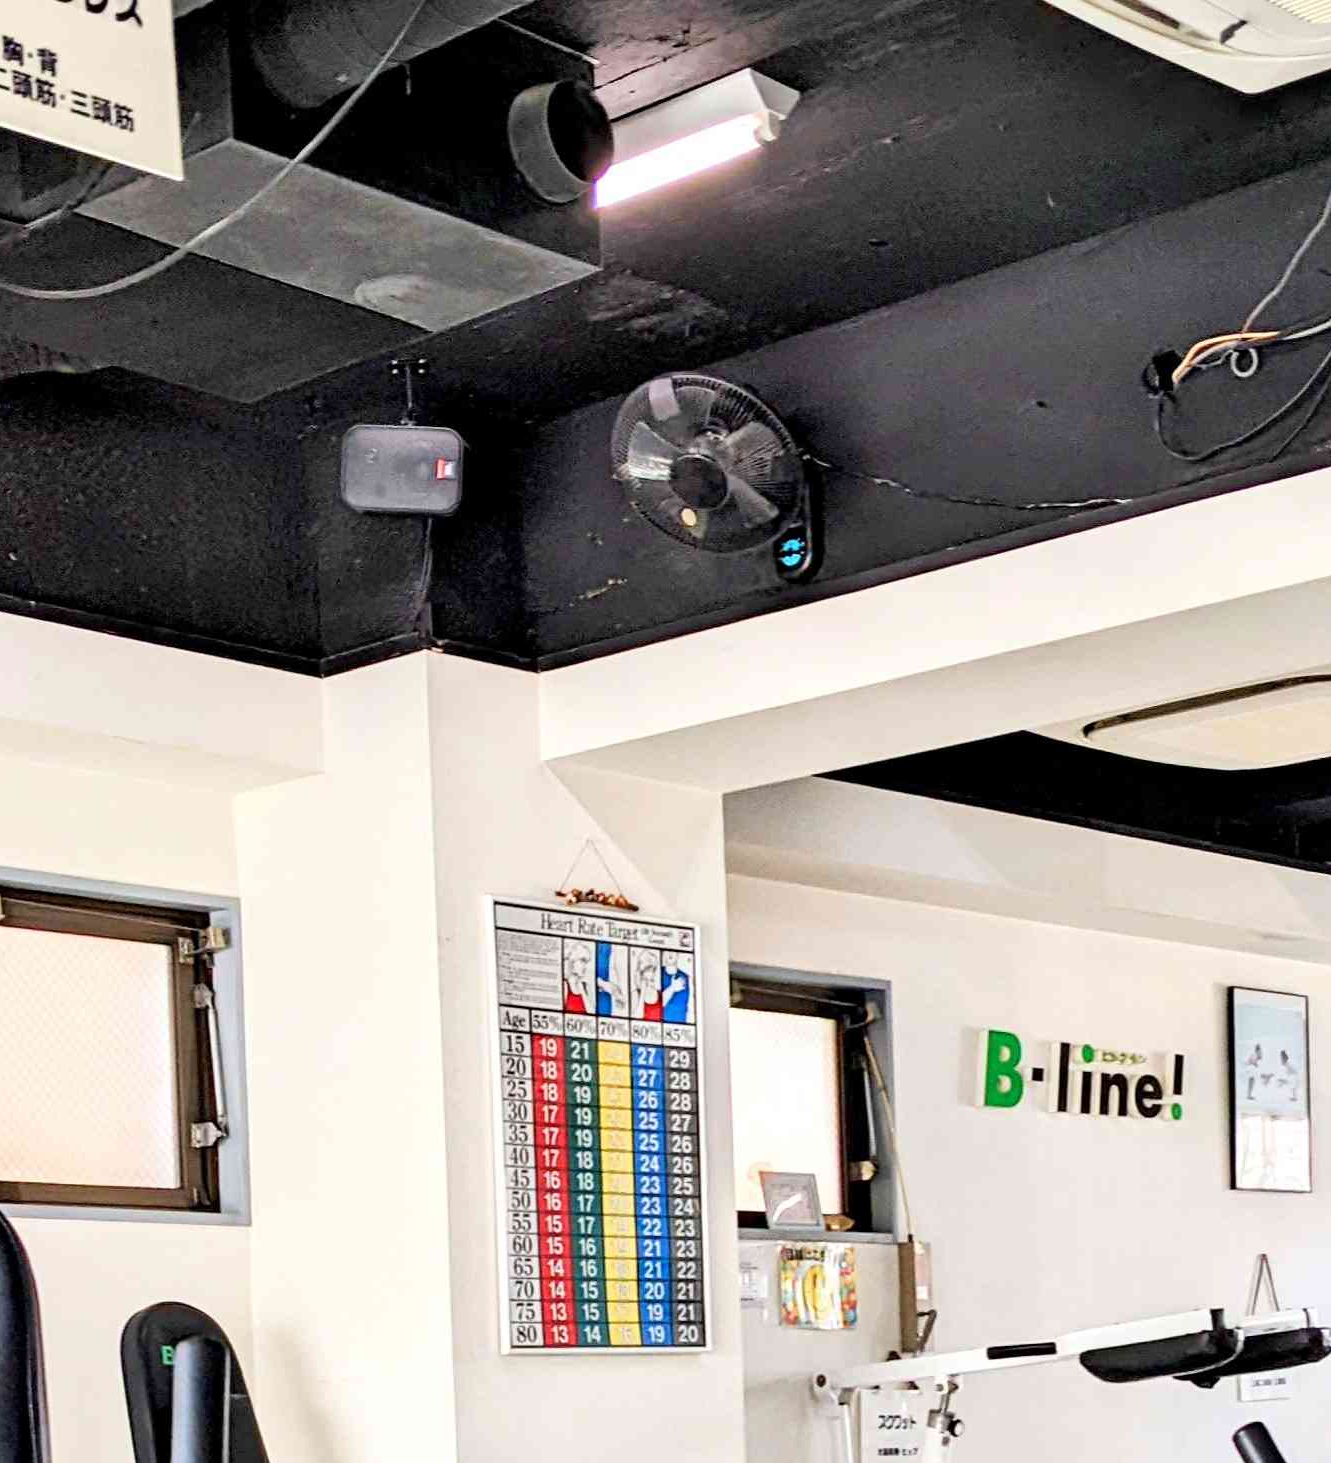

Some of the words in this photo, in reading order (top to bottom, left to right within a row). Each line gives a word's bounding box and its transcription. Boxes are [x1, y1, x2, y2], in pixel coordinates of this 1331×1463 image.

[541, 913, 573, 934] Heart
[578, 917, 604, 937] Rate
[605, 921, 637, 941] Target
[503, 1011, 526, 1028] Age
[532, 1014, 560, 1031] 55%
[565, 1017, 595, 1034] 60%
[600, 1021, 627, 1037] 70%
[633, 1024, 661, 1041] 80%
[507, 1035, 524, 1053] 15
[540, 1039, 557, 1057] 19
[571, 1041, 588, 1059] 21
[638, 1047, 656, 1065] 27
[669, 1050, 690, 1068] 29
[506, 1057, 526, 1075] 20
[541, 1061, 557, 1079] 18
[572, 1063, 591, 1081] 20
[638, 1069, 656, 1087] 27
[670, 1072, 690, 1090] 28
[507, 1080, 526, 1097] 25
[541, 1083, 558, 1101] 18
[574, 1086, 591, 1104] 19
[639, 1091, 658, 1109] 26
[671, 1093, 691, 1111] 28
[508, 1103, 527, 1120] 30
[542, 1105, 558, 1122] 17
[575, 1108, 592, 1125] 19
[639, 1112, 658, 1130] 25
[671, 1114, 691, 1132] 27
[509, 1124, 528, 1142] 35
[543, 1127, 559, 1145] 17
[576, 1129, 592, 1147] 19
[640, 1133, 659, 1151] 25
[672, 1135, 692, 1153] 26
[510, 1147, 529, 1165] 40
[543, 1149, 559, 1166] 17
[576, 1151, 593, 1169] 18
[640, 1155, 659, 1172] 24
[672, 1157, 693, 1174] 26
[510, 1169, 529, 1187] 45
[544, 1171, 560, 1189] 16
[577, 1173, 594, 1190] 18
[641, 1176, 660, 1194] 23
[673, 1177, 693, 1195] 25
[512, 1191, 530, 1210] 50
[545, 1193, 561, 1210] 16
[578, 1195, 594, 1212] 17
[641, 1197, 661, 1215] 23
[674, 1198, 694, 1215] 24
[513, 1213, 531, 1232] 55
[546, 1215, 562, 1232] 15
[578, 1216, 595, 1234] 17
[643, 1218, 661, 1236] 22
[675, 1219, 695, 1236] 23
[513, 1236, 532, 1253] 60
[547, 1237, 563, 1254] 15
[579, 1238, 596, 1256] 16
[644, 1239, 661, 1257] 21
[676, 1240, 696, 1257] 23
[514, 1258, 533, 1275] 65
[548, 1259, 564, 1276] 14
[581, 1259, 597, 1277] 16
[645, 1261, 661, 1278] 21
[677, 1262, 696, 1278] 22
[515, 1281, 534, 1298] 70
[549, 1281, 565, 1298] 14
[581, 1281, 598, 1299] 15
[645, 1282, 664, 1299] 20
[677, 1282, 694, 1299] 21
[516, 1303, 535, 1319] 75
[551, 1303, 567, 1320] 13
[583, 1303, 599, 1321] 15
[647, 1303, 663, 1321] 19
[677, 1304, 695, 1321] 21
[517, 1326, 537, 1342] 80
[552, 1325, 568, 1343] 13
[584, 1326, 601, 1342] 14
[649, 1325, 664, 1343] 19
[678, 1325, 698, 1342] 20
